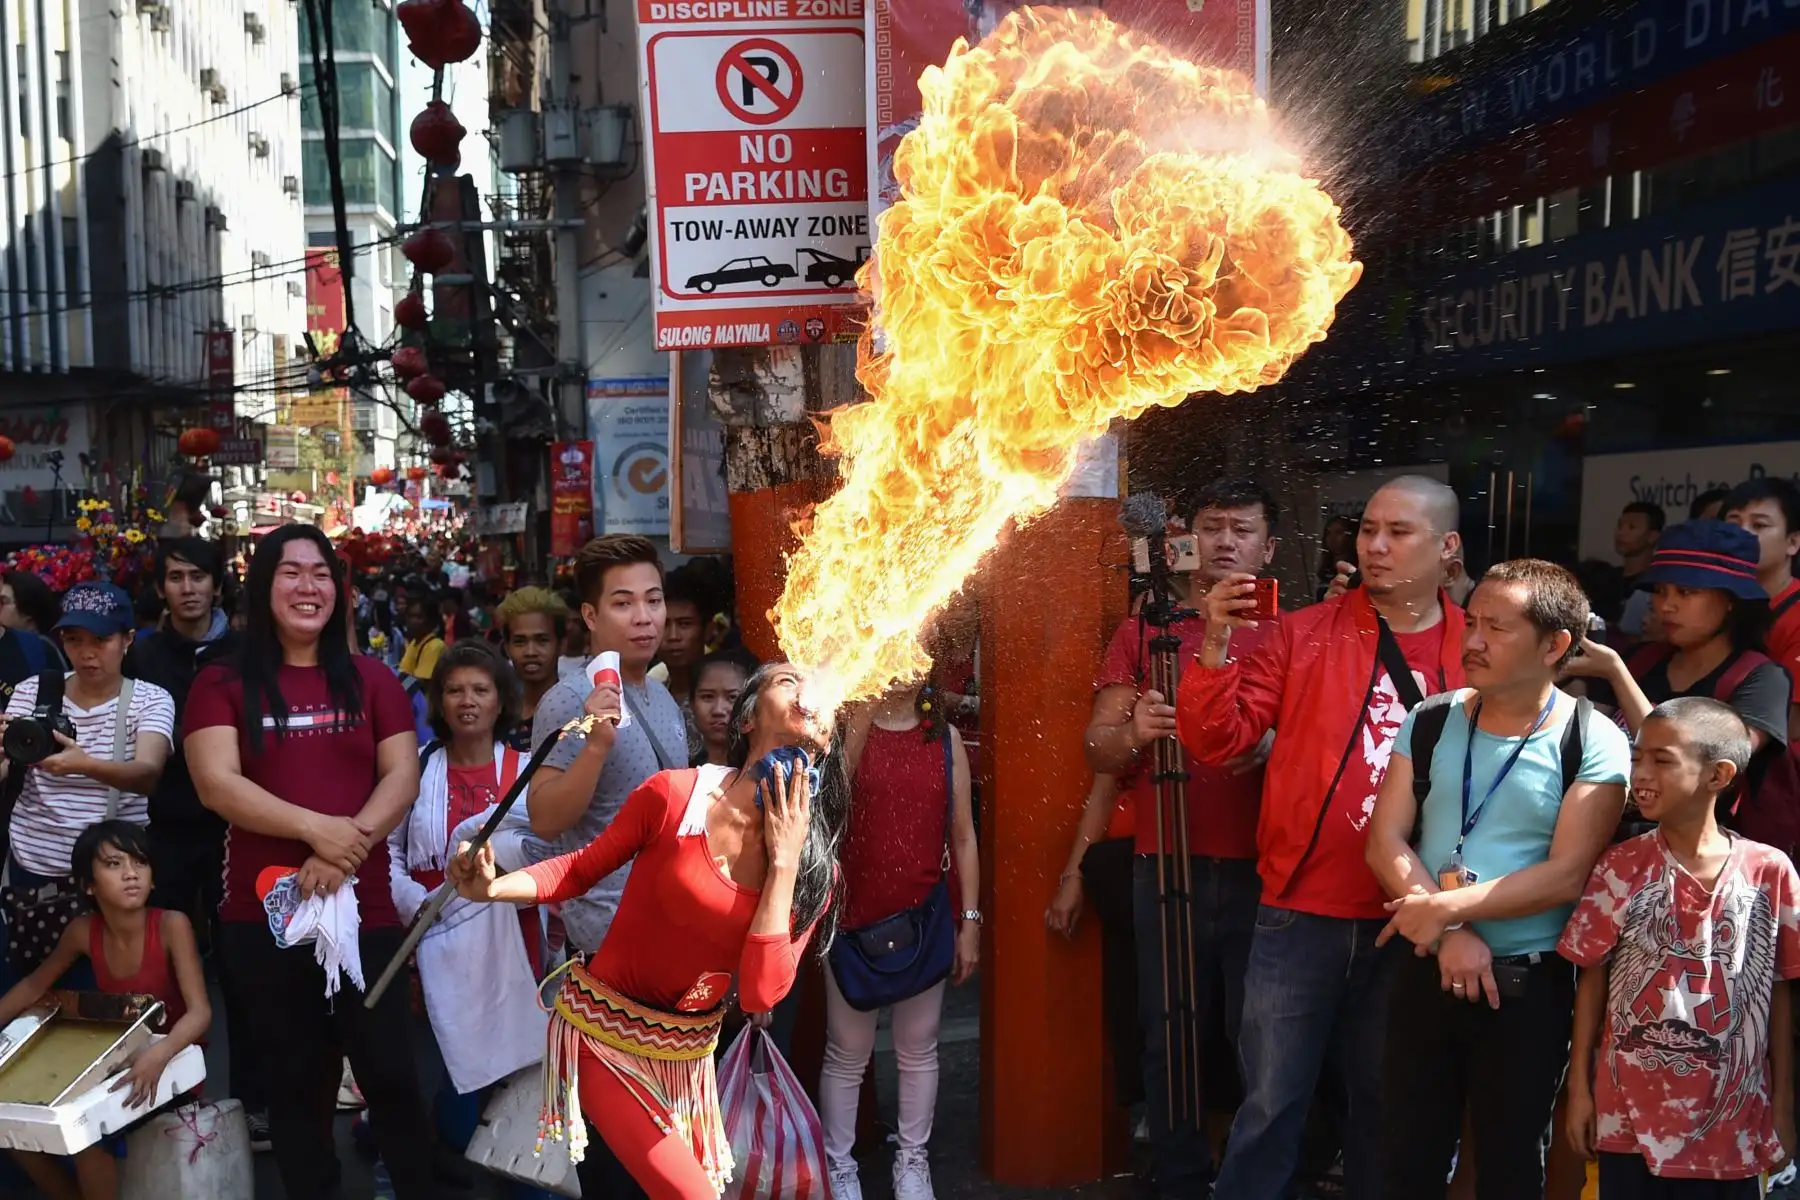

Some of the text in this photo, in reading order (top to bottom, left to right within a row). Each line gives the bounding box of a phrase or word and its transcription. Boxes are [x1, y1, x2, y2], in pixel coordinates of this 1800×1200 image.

[650, 0, 863, 20] DISCIPLINE ZONE
[1509, 17, 1657, 117] WORLD
[1683, 0, 1800, 49] DIA
[740, 133, 792, 164] NO
[684, 168, 848, 202] PARKING
[670, 215, 868, 242] TOW-AWAY ZONE
[1424, 235, 1705, 354] SECURITY BANK
[658, 322, 770, 347] SULONG MAYNILA
[1629, 471, 1697, 506] Switch
